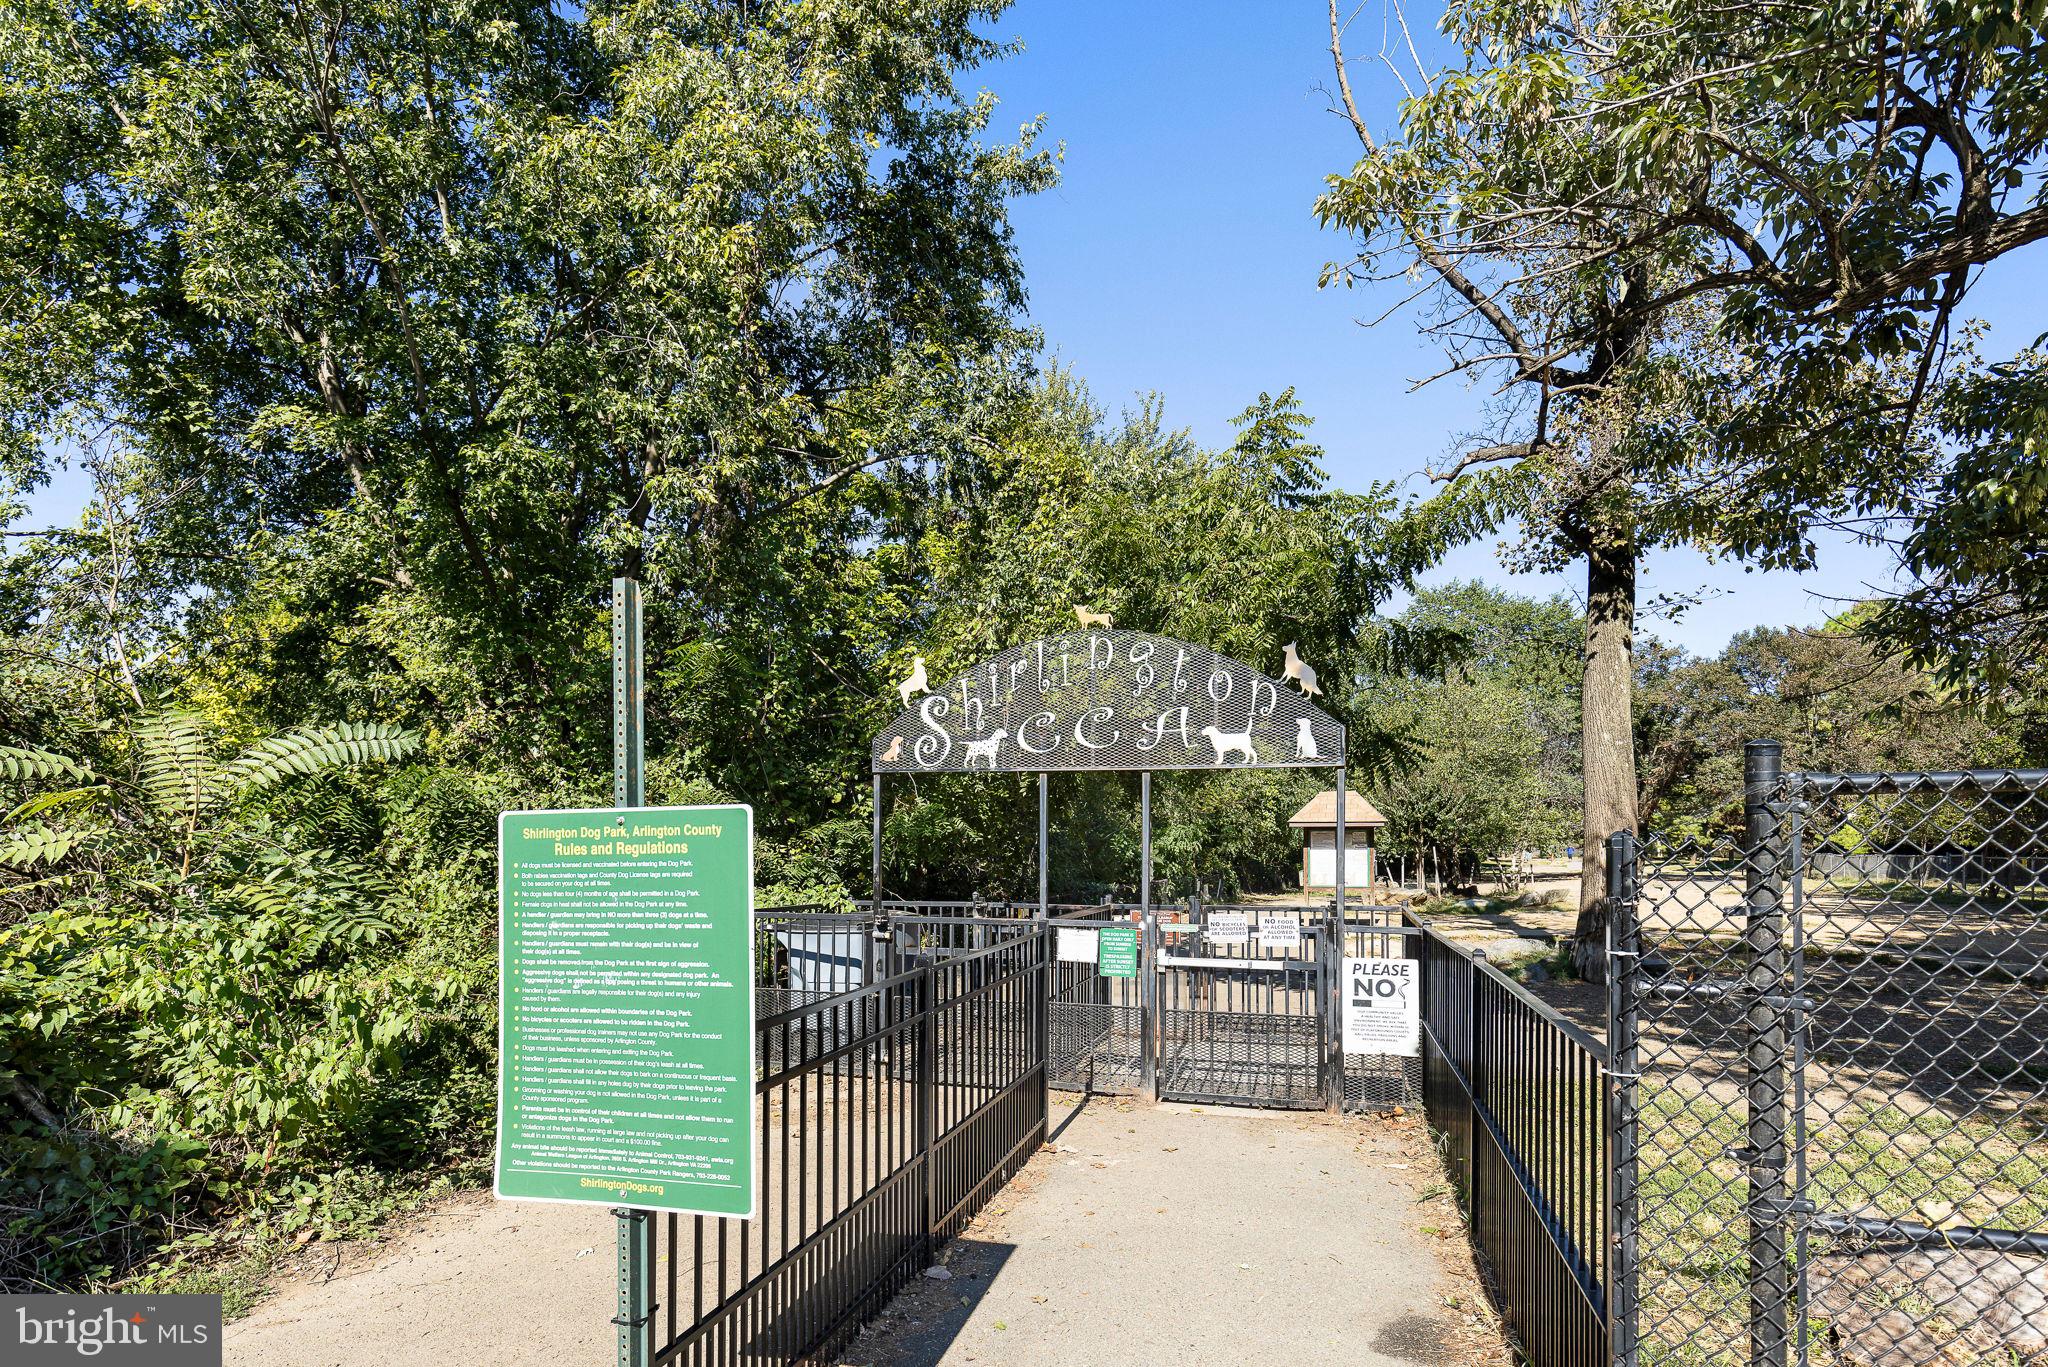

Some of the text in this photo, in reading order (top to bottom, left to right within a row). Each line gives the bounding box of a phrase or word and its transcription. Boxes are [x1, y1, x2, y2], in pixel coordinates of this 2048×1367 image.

[914, 635, 1278, 769] Shirlington
[522, 824, 721, 841] Shirlington Dog Park, Arlington County
[554, 841, 688, 856] Rules and Regulations
[1352, 963, 1409, 976] PLEASE
[1354, 978, 1396, 998] NO
[665, 1009, 677, 1017] Dog
[590, 1047, 611, 1055] entering
[648, 1049, 659, 1057] Dog
[521, 1094, 539, 1102] County
[540, 1095, 566, 1103] sponsored
[528, 1113, 557, 1121] antagonize
[580, 1178, 664, 1195] ShirlingtonDogs.org
